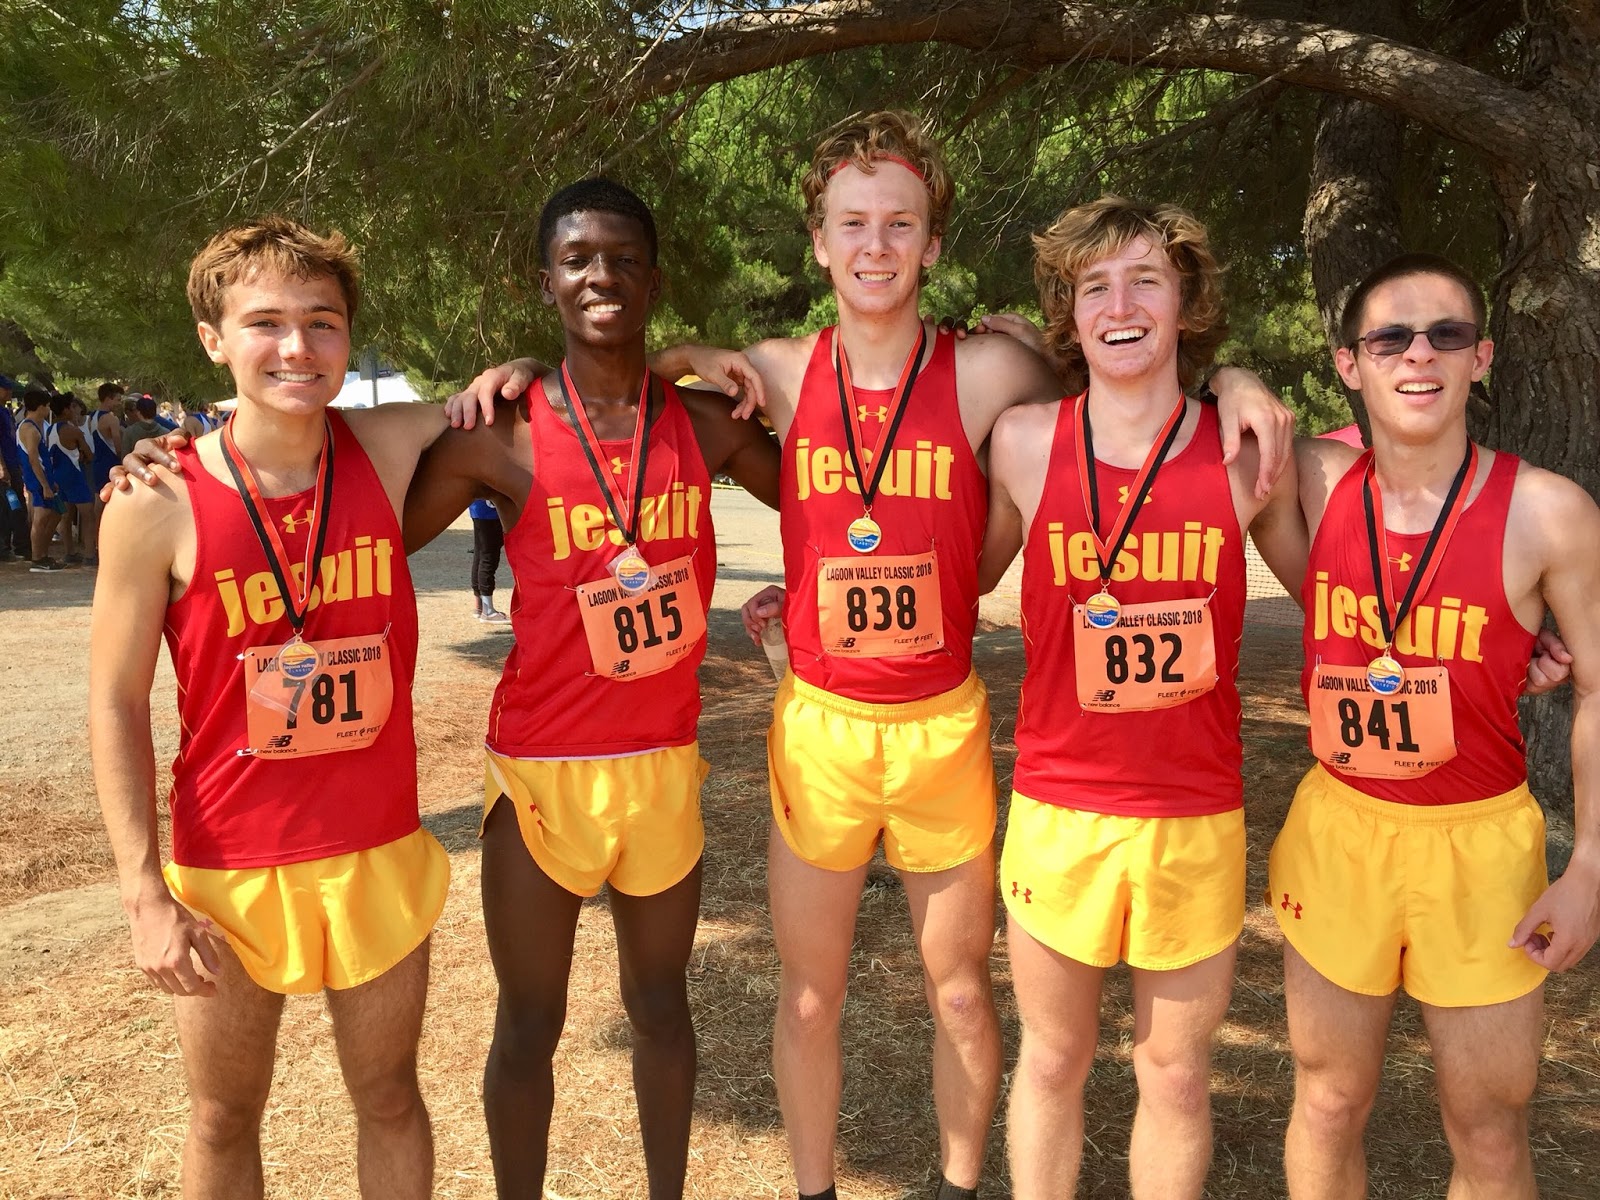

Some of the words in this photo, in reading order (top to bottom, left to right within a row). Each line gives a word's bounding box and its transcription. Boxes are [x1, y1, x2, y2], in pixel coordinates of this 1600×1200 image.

[796, 438, 954, 501] jesuit
[547, 482, 702, 560] jesuit
[826, 567, 853, 581] LAGOON
[855, 566, 882, 580] VALLEY
[884, 566, 914, 579] CLASSIC
[916, 562, 932, 577] 2018
[1048, 521, 1225, 587] jesuit
[587, 587, 618, 607] LAGOON
[674, 568, 689, 584] 2018
[846, 585, 916, 632] 838
[613, 592, 682, 654] 815
[920, 633, 934, 641] FEET
[1147, 611, 1180, 627] CLASSIC
[1182, 610, 1202, 624] 2018
[1314, 571, 1489, 663] jesuit
[328, 648, 361, 666] CLASSIC
[363, 646, 381, 661] 2018
[1105, 632, 1184, 684] 832
[283, 670, 363, 729] 781
[1317, 675, 1344, 690] LAGOON
[1346, 678, 1374, 692] VALLE
[1415, 679, 1437, 694] 2018
[336, 730, 358, 738] FLEET
[366, 725, 381, 734] FEET
[1338, 698, 1419, 753] 841
